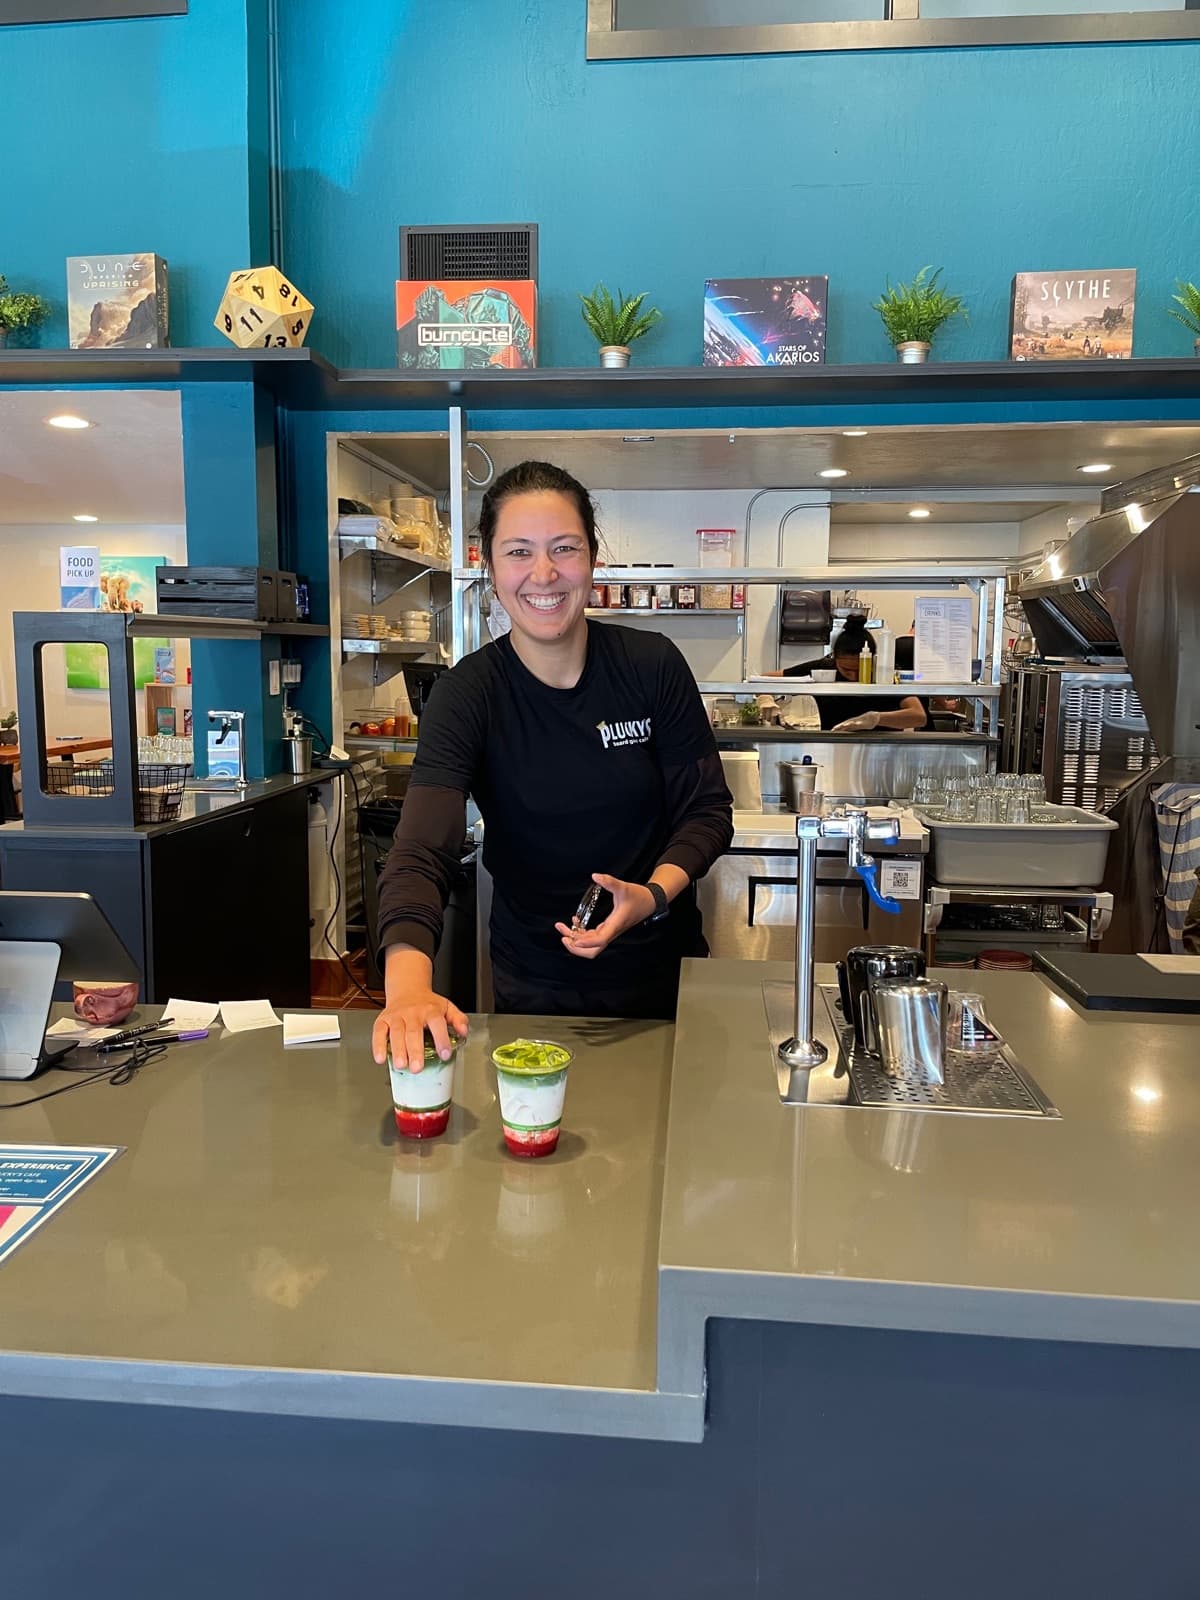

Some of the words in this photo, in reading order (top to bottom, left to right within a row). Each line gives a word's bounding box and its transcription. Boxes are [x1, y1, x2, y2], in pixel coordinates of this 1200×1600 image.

[80, 262, 145, 273] DUNE
[83, 280, 139, 289] UPRISING
[1041, 279, 1111, 308] SCYTHE
[240, 308, 263, 332] 11
[421, 327, 509, 345] burncycle
[766, 352, 820, 365] AKARIOS
[67, 557, 94, 567] FOOD
[67, 569, 83, 577] PICK
[84, 569, 95, 577] UP
[0, 1162, 73, 1170] EXPERIENCE
